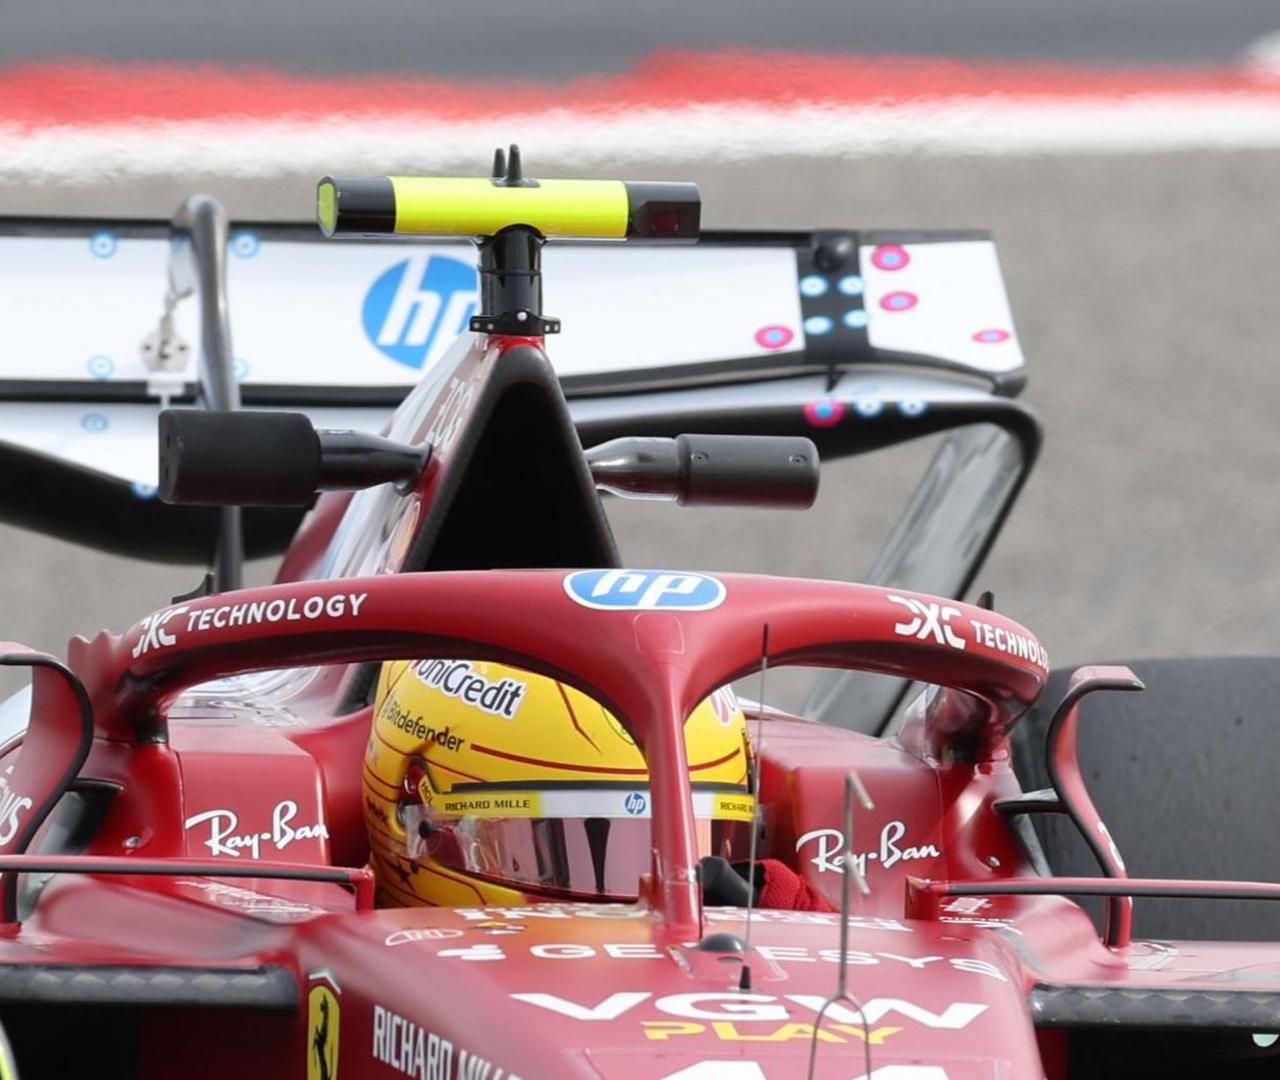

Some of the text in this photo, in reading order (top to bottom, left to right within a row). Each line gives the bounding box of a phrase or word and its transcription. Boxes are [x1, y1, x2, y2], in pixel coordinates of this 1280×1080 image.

[584, 569, 714, 608] hp
[187, 593, 368, 631] TECHNOLOGY
[885, 594, 967, 650] DXC
[444, 798, 531, 812] RICHARD MILLE
[626, 793, 647, 815] hp
[184, 800, 330, 860] Ray-Ban
[796, 820, 940, 877] Ray-Ban
[529, 943, 1008, 982] GEESYS
[510, 992, 988, 1029] VGW
[640, 1021, 904, 1044] PLAY
